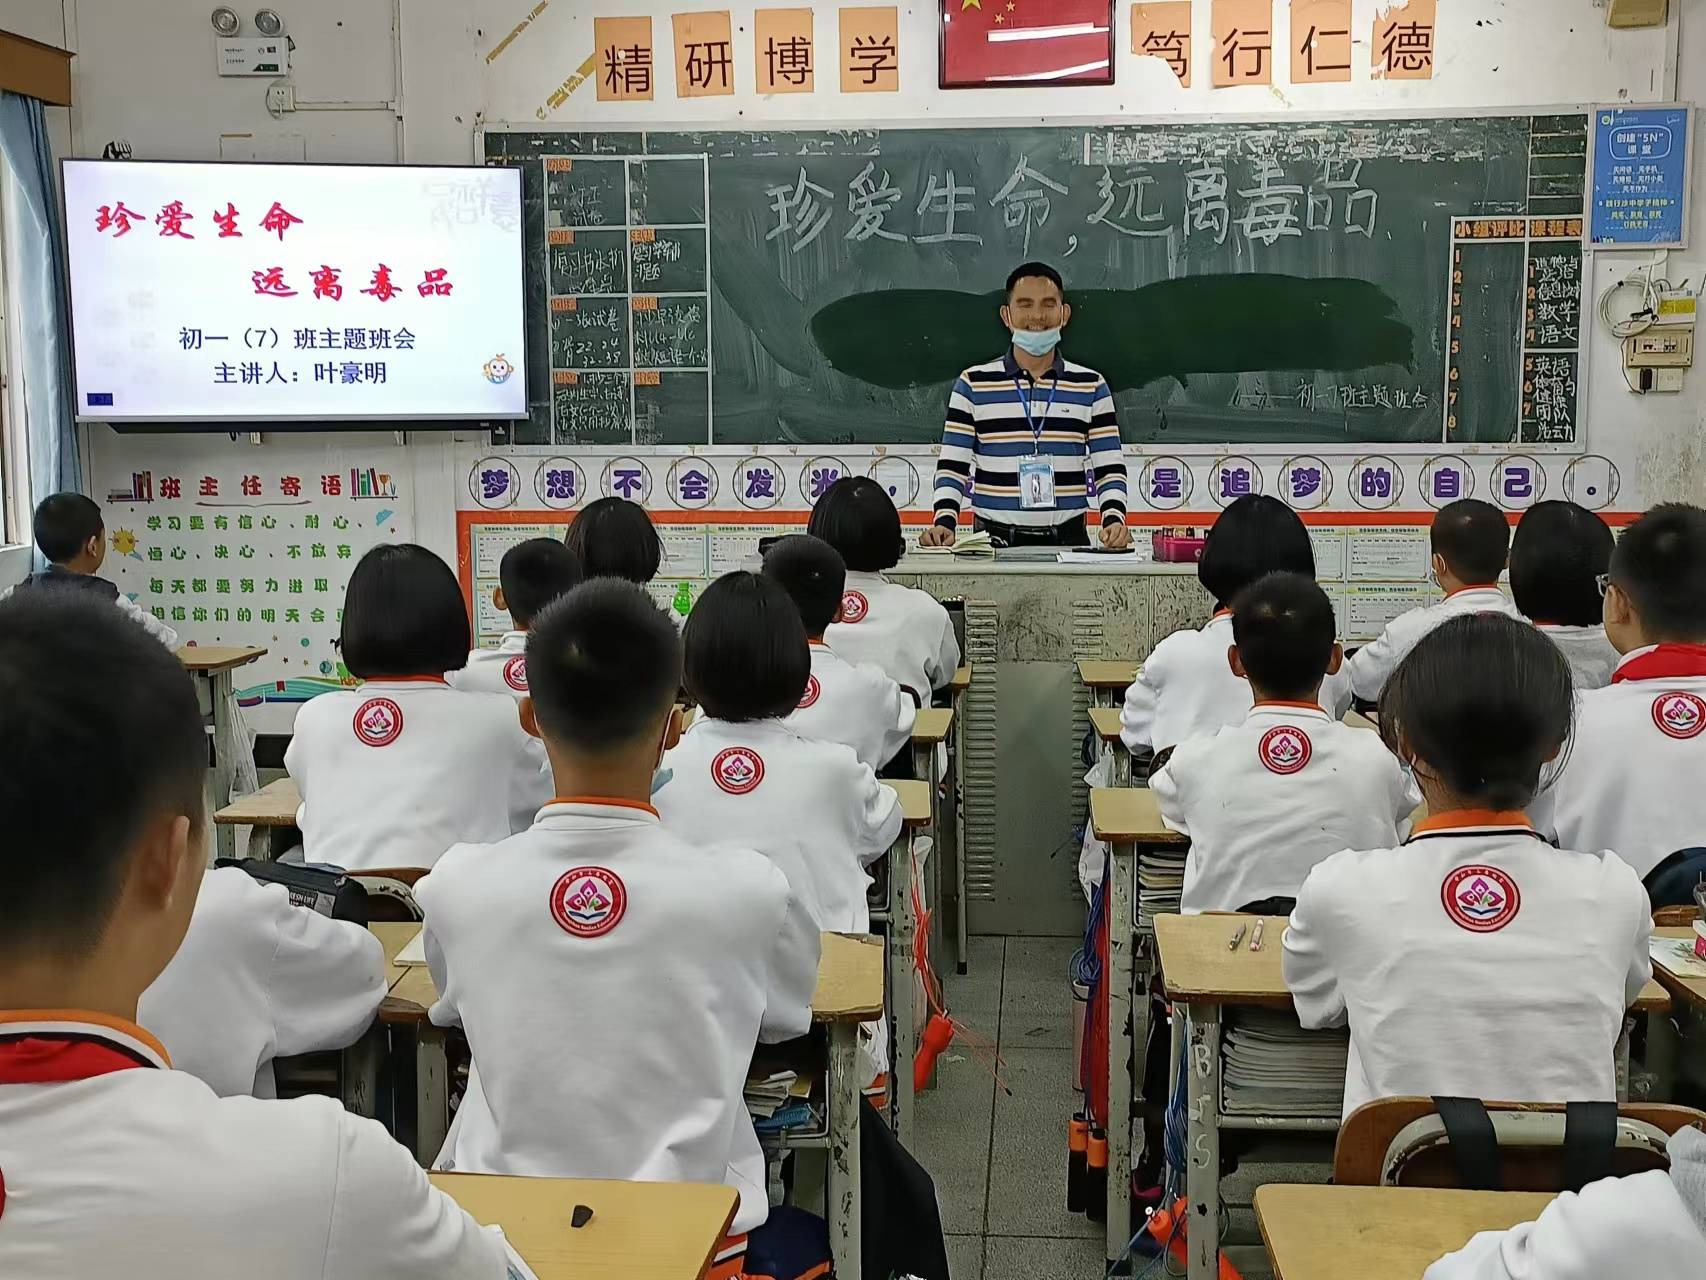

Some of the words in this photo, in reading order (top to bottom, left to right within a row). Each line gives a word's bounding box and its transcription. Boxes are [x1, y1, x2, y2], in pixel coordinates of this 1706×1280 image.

[605, 36, 898, 94] 精研博学
[95, 200, 304, 242] 珍爱生命
[252, 263, 453, 302] 远离毒品
[1538, 300, 1577, 322] 数学
[179, 326, 416, 350] 初一（7）班主题班会
[1538, 324, 1577, 344] 语文
[214, 361, 387, 385] 主讲人：叶豪明
[1535, 355, 1571, 377] 英语
[160, 474, 342, 499] 班主任寄语
